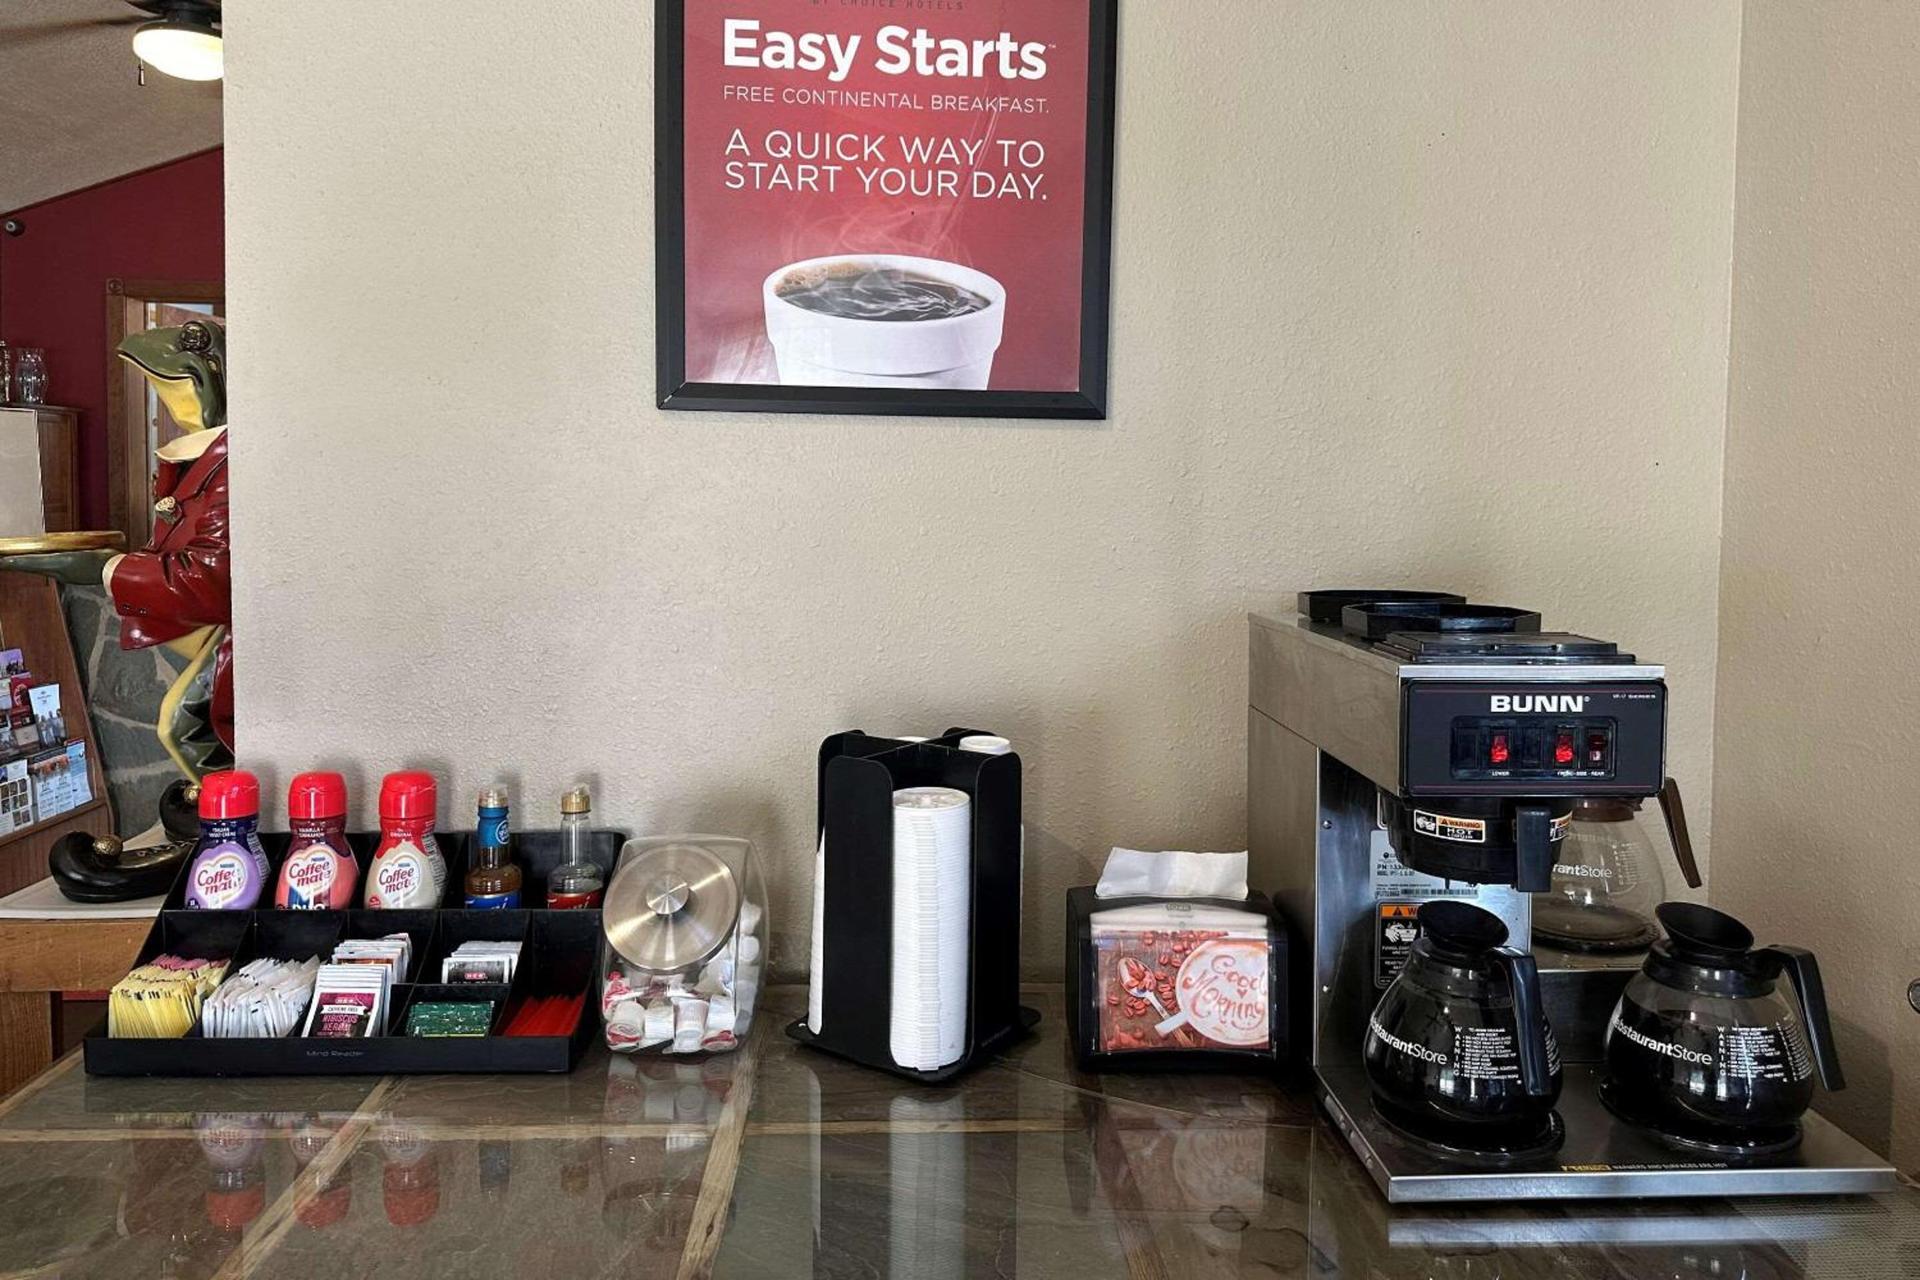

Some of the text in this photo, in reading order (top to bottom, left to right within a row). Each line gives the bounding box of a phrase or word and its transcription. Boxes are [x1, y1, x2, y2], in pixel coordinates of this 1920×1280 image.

[840, 0, 895, 8] CHOICE
[906, 1, 964, 10] HOTELS
[723, 18, 1047, 82] Easy Starts
[723, 85, 1050, 114] FREE CONTINENTAL BREAKFAST.
[725, 128, 1045, 168] A QUICK WAY TO
[725, 162, 1048, 201] START YOUR DAY.
[1490, 695, 1584, 713] BUNN
[1446, 827, 1475, 836] HOT
[289, 861, 330, 879] Coffee
[379, 866, 415, 886] Coffee
[1552, 863, 1613, 878] rantStore
[204, 878, 237, 896] mat
[1211, 954, 1269, 997] Good
[1611, 1015, 1713, 1065] ebstaurantStore
